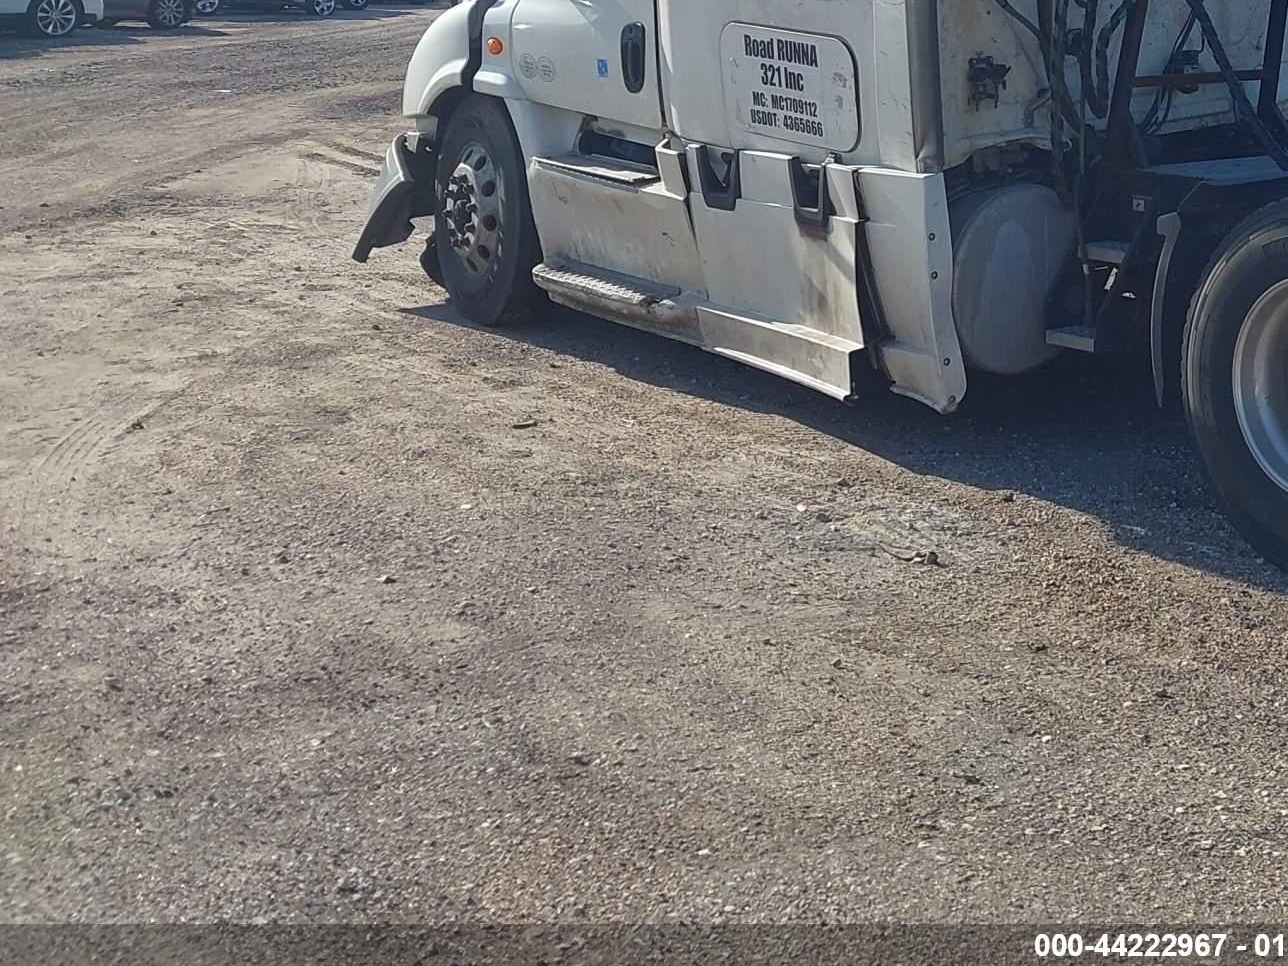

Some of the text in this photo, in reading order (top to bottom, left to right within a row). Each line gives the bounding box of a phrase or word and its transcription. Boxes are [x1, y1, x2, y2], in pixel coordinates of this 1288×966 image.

[744, 34, 818, 67] Road RUNNA
[760, 63, 804, 92] 321 Inc
[752, 91, 818, 117] MC: MC1709112
[750, 109, 823, 137] USDOT: 4365666
